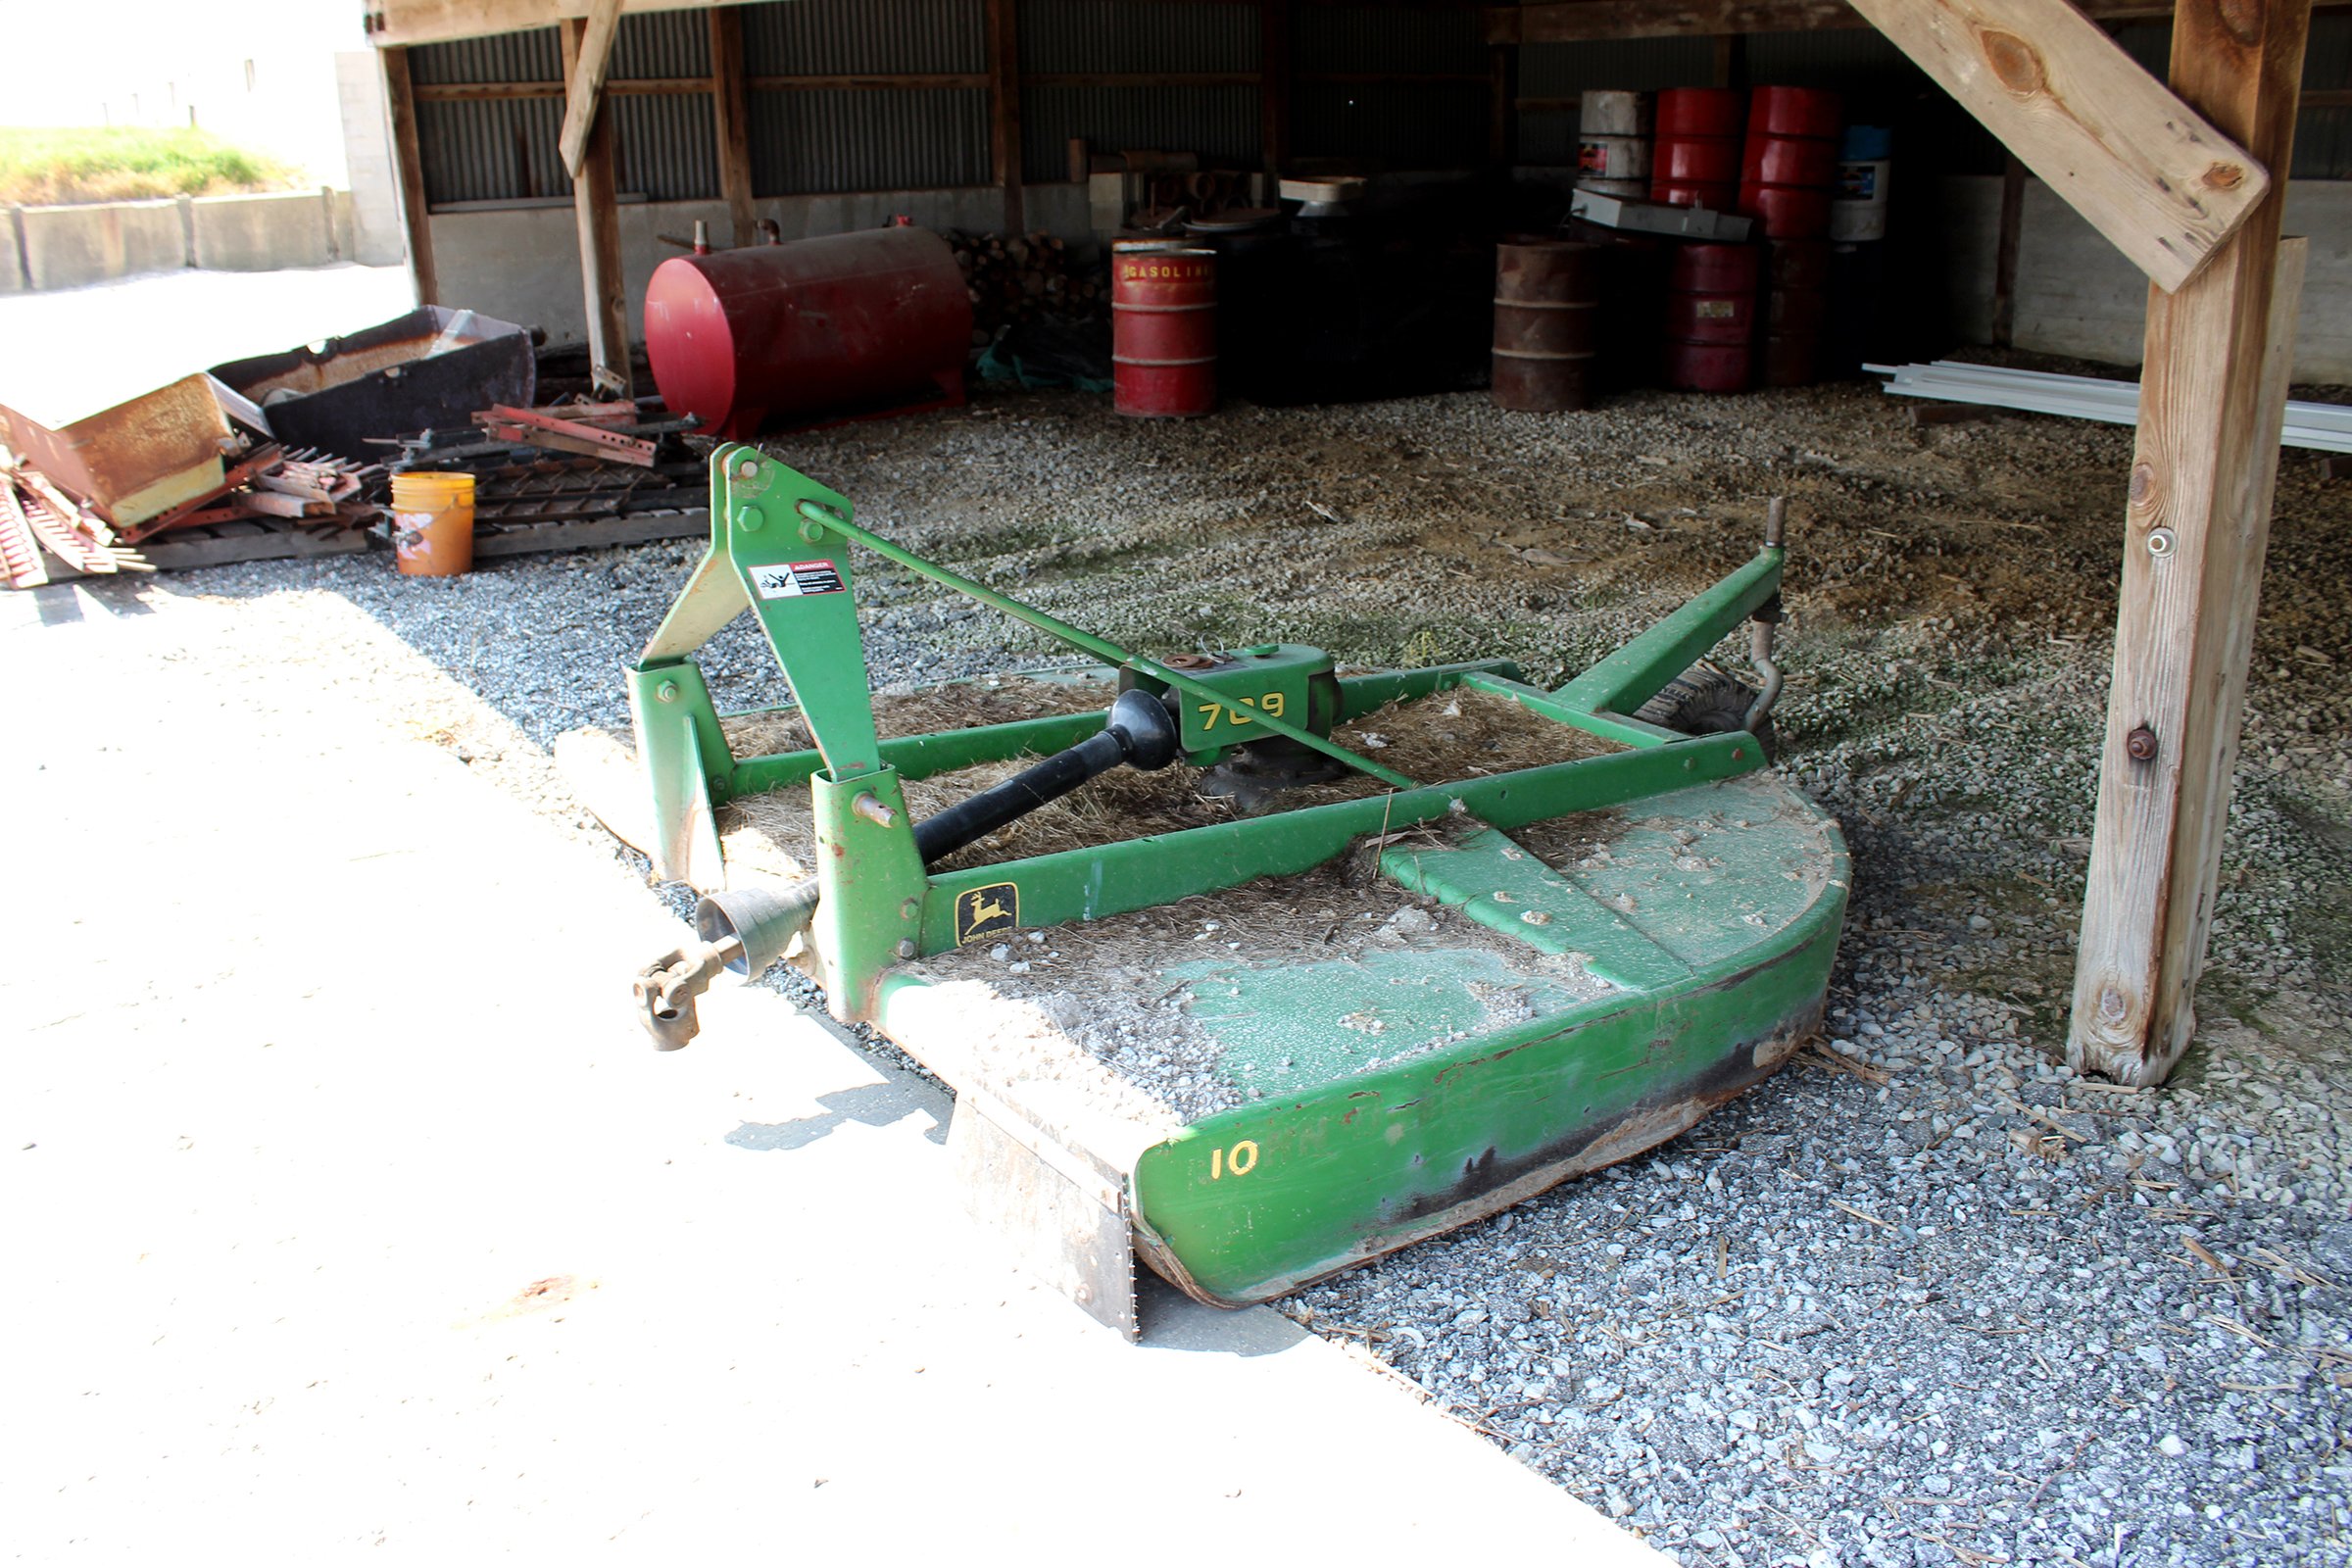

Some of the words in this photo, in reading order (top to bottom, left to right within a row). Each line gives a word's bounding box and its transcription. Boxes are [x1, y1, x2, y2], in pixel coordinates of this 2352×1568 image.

[800, 562, 829, 570] DANGER
[961, 932, 985, 944] JOHN
[986, 926, 1012, 938] DEER
